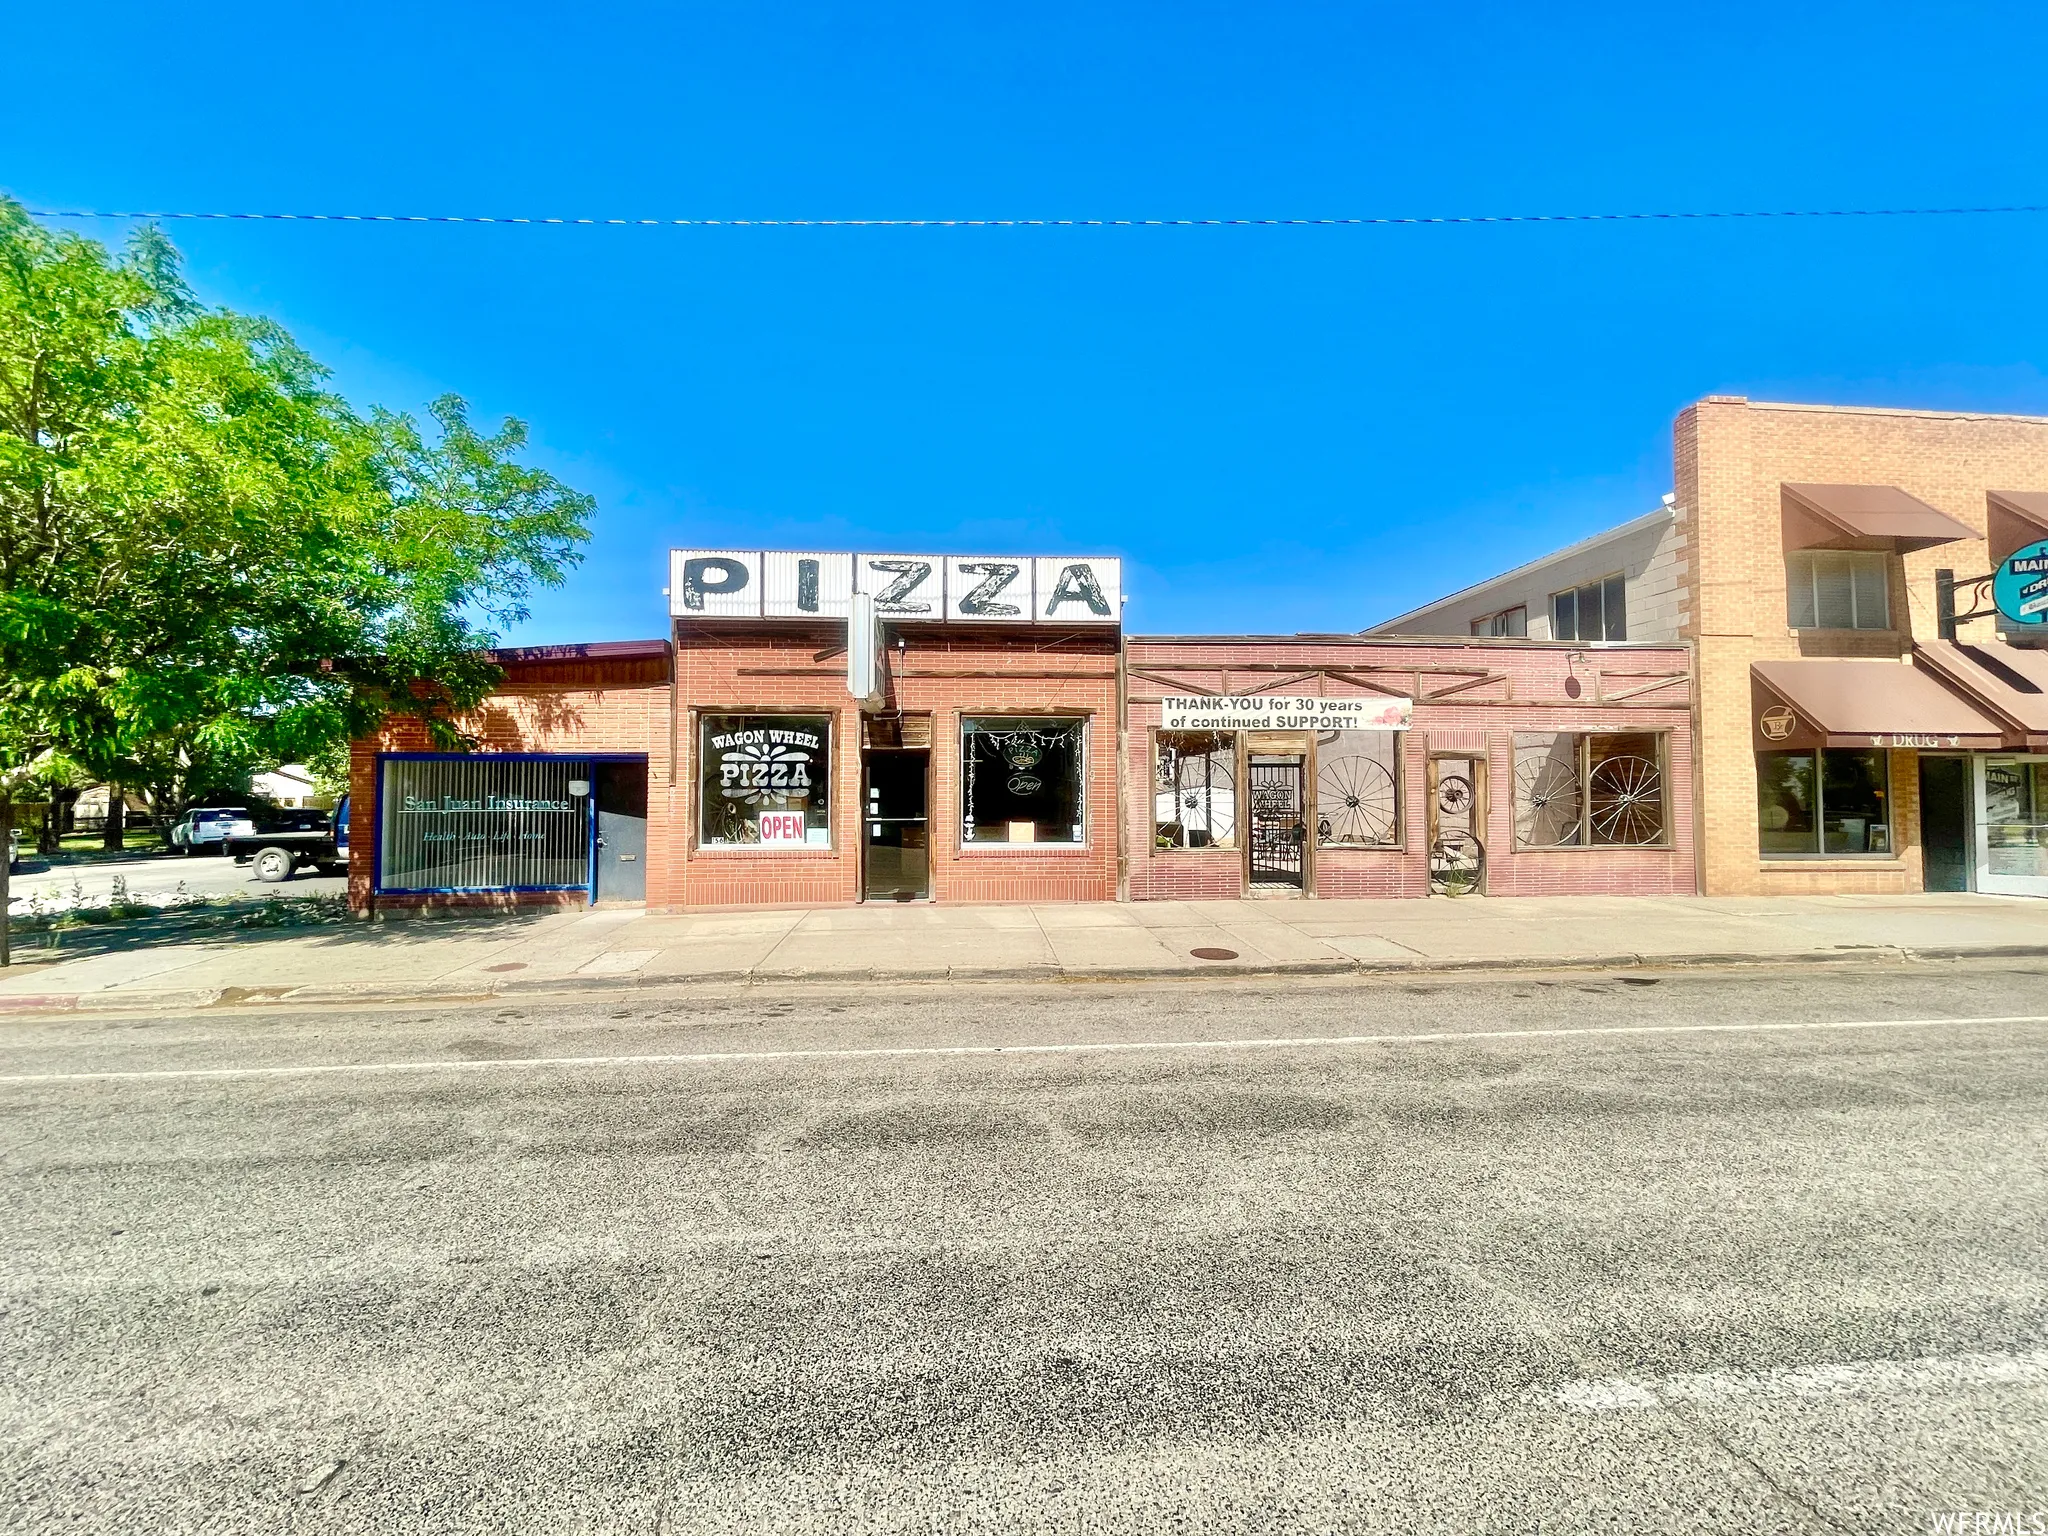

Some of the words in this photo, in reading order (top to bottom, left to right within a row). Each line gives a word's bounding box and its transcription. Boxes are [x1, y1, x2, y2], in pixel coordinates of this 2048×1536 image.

[683, 557, 1112, 617] PIZZA
[2029, 579, 2048, 593] DR
[1165, 697, 1264, 711] THANK-YOU
[1268, 698, 1291, 711] for
[1295, 699, 1314, 712] 30
[1319, 702, 1363, 713] years
[1170, 716, 1186, 728] of
[1190, 716, 1271, 728] continued
[1276, 716, 1358, 729] SUPPORT!
[711, 729, 765, 749] WAGON
[769, 729, 819, 749] WHEEL
[1892, 734, 1938, 748] DRUG
[1008, 745, 1039, 757] PIZZA
[720, 763, 812, 787] PIZZA
[1007, 777, 1042, 792] Open
[1252, 790, 1292, 800] WAGON
[404, 795, 437, 811] San
[443, 795, 482, 814] Juan
[487, 795, 569, 811] Insurance
[761, 815, 803, 839] OPEN
[423, 831, 456, 842] Health
